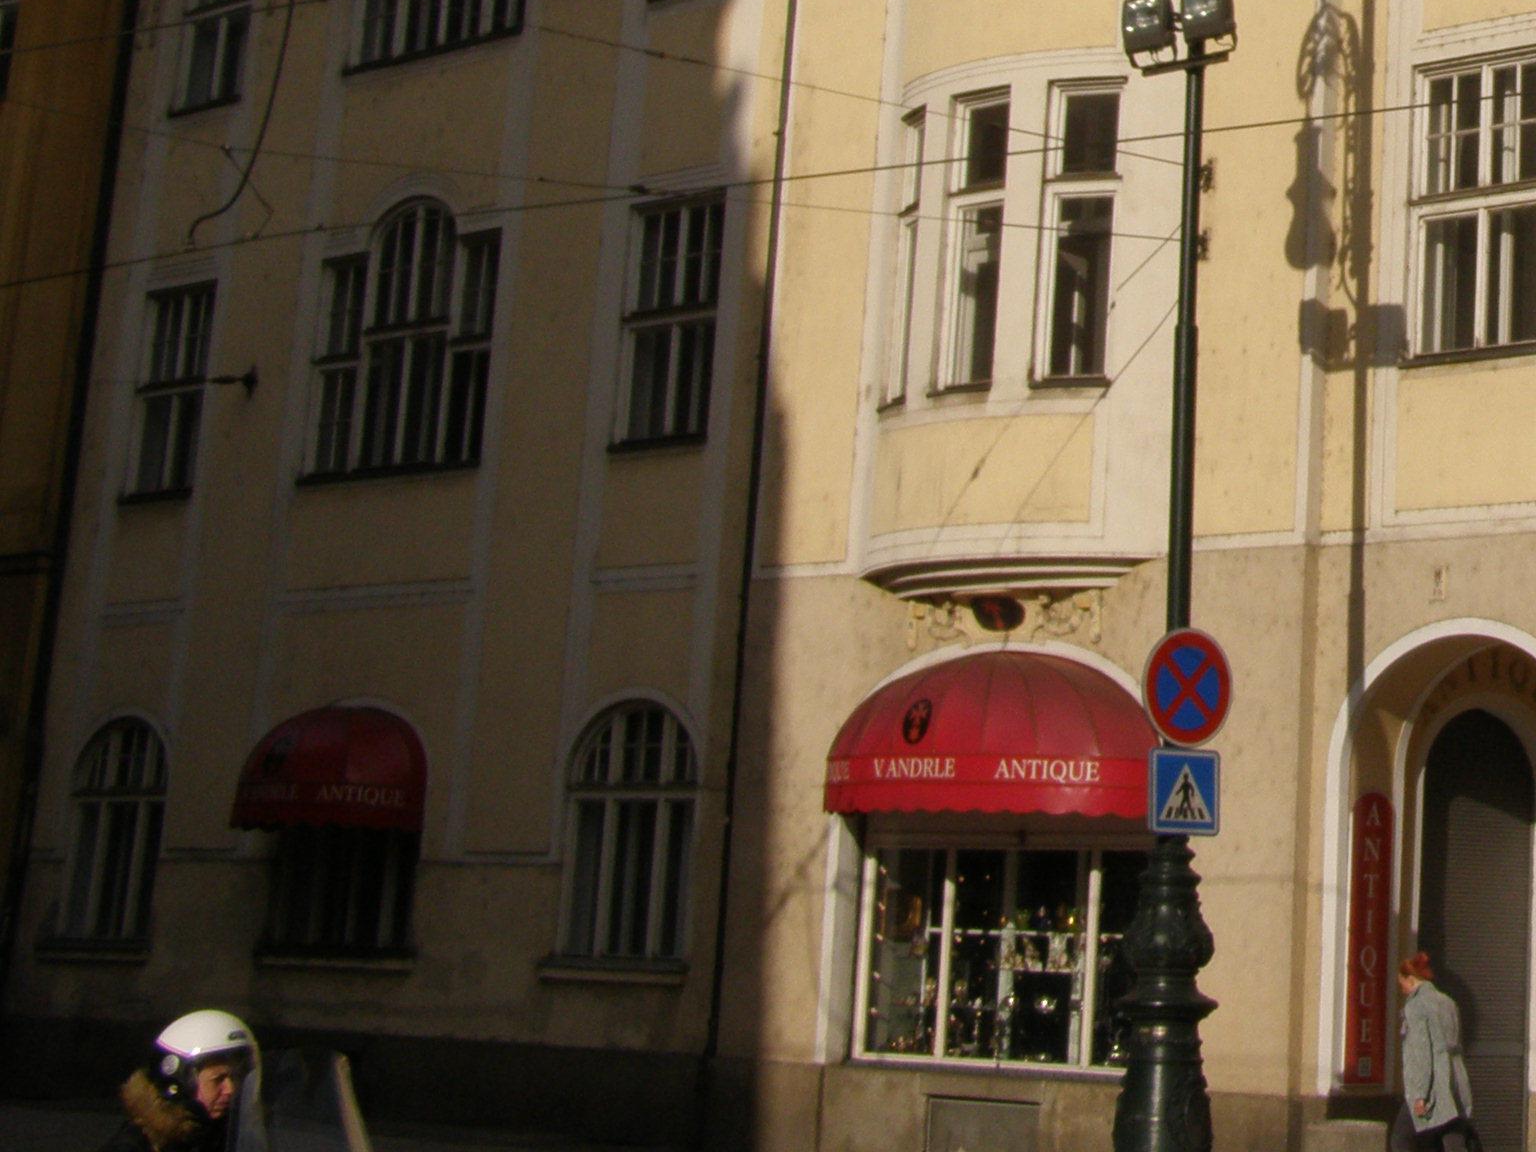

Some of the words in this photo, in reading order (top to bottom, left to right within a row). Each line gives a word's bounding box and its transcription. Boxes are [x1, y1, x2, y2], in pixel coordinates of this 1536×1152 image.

[886, 757, 956, 779] ANDRLE
[994, 759, 1100, 784] ANTIQUE
[1359, 801, 1382, 1043] ANTIQUE
